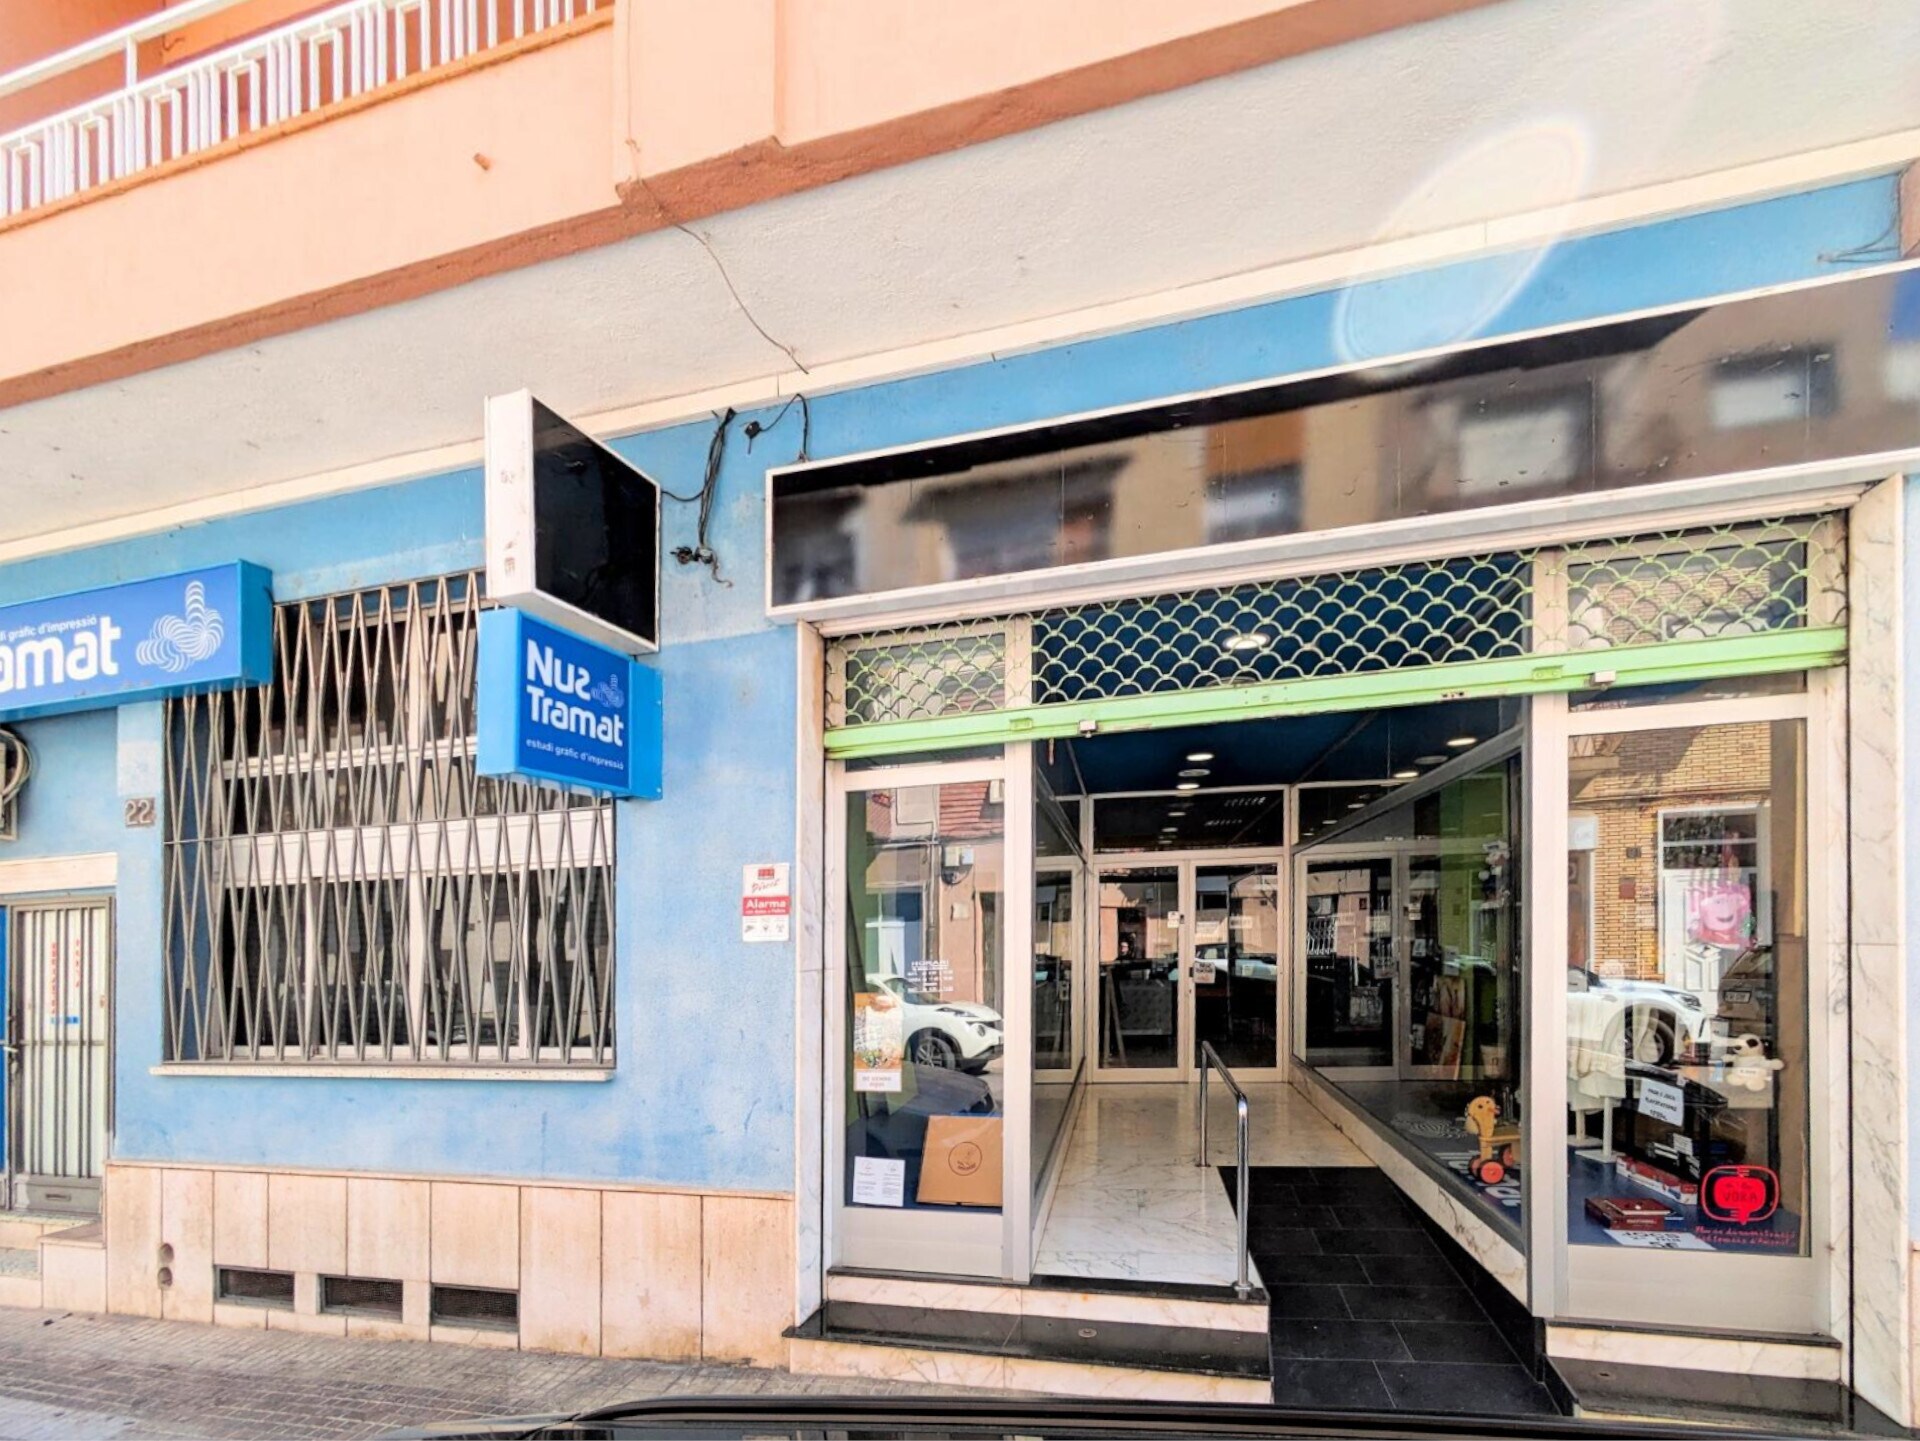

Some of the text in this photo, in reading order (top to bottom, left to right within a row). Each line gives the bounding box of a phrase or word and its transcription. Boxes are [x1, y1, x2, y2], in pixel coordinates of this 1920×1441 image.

[526, 684, 624, 747] Tramat
[125, 799, 152, 825] 22
[746, 898, 787, 909] Alarma
